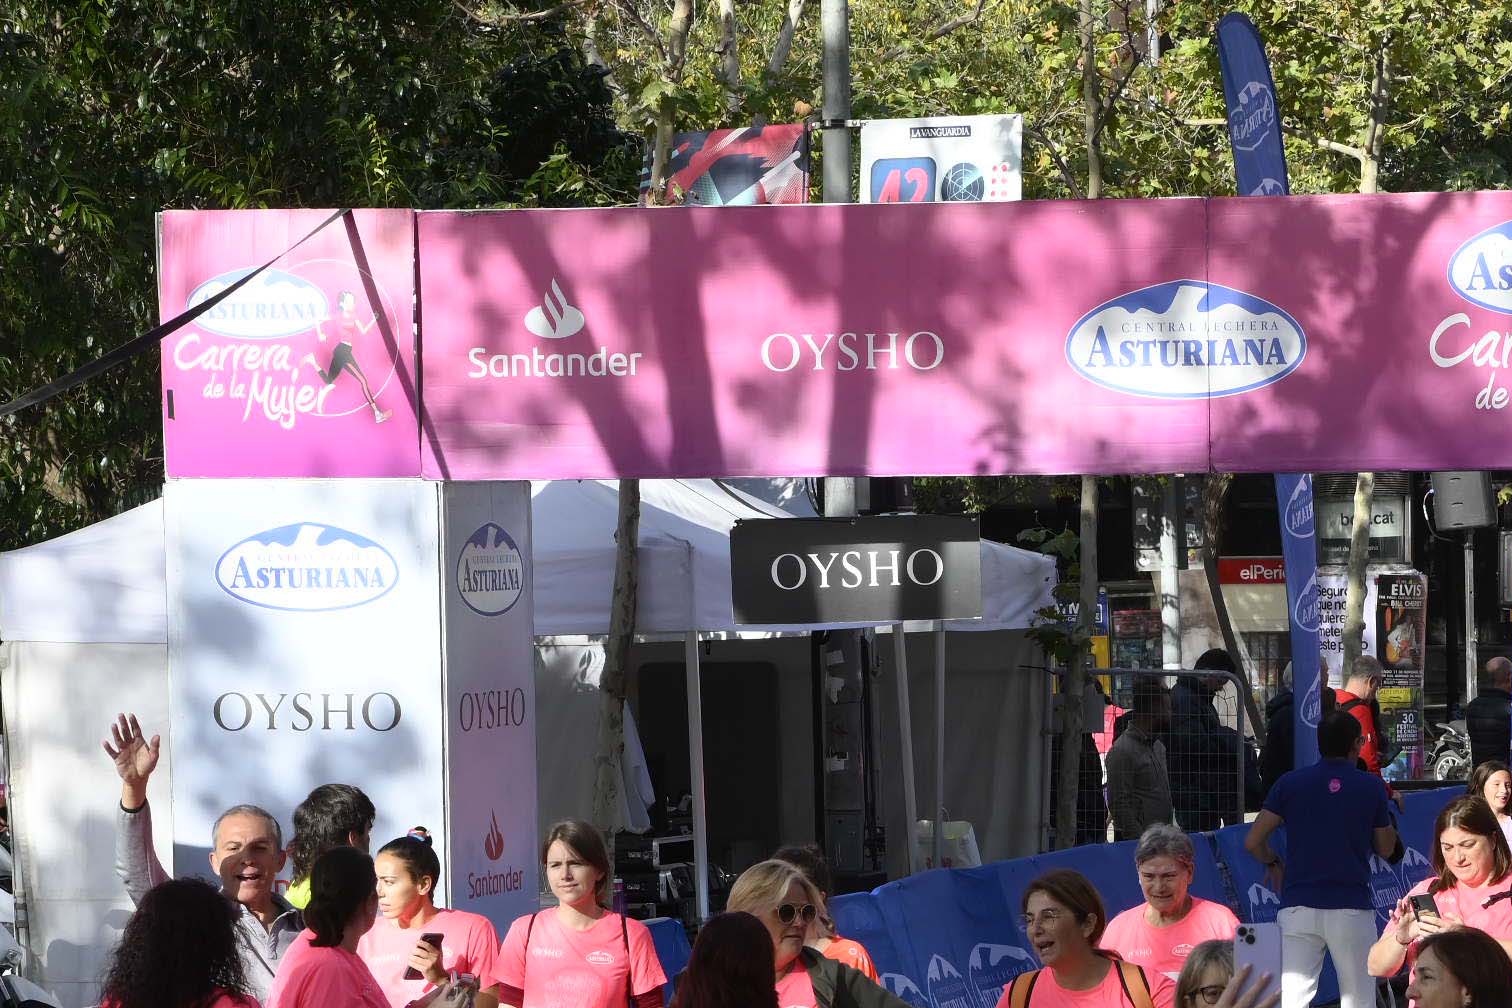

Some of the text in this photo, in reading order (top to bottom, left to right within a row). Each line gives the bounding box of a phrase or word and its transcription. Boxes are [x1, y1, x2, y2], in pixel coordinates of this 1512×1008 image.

[1121, 321, 1196, 334] CENTRAL
[173, 333, 291, 371] Carrera
[467, 346, 642, 379] Santander
[760, 331, 945, 372] OYSHO
[1085, 325, 1288, 368] ASTURIANA
[203, 367, 337, 430] de la Mujer
[1475, 372, 1510, 411] de
[1340, 511, 1395, 526] b.cat
[230, 556, 386, 589] ASTURIANA
[461, 558, 520, 593] ASTURIANA
[770, 548, 944, 591] OYSHO
[1240, 563, 1286, 581] elPeri
[1391, 583, 1422, 597] ELVIS
[212, 691, 403, 732] OYSHO
[459, 687, 526, 732] OYSHO
[1402, 712, 1414, 724] 30
[468, 868, 523, 900] Santander
